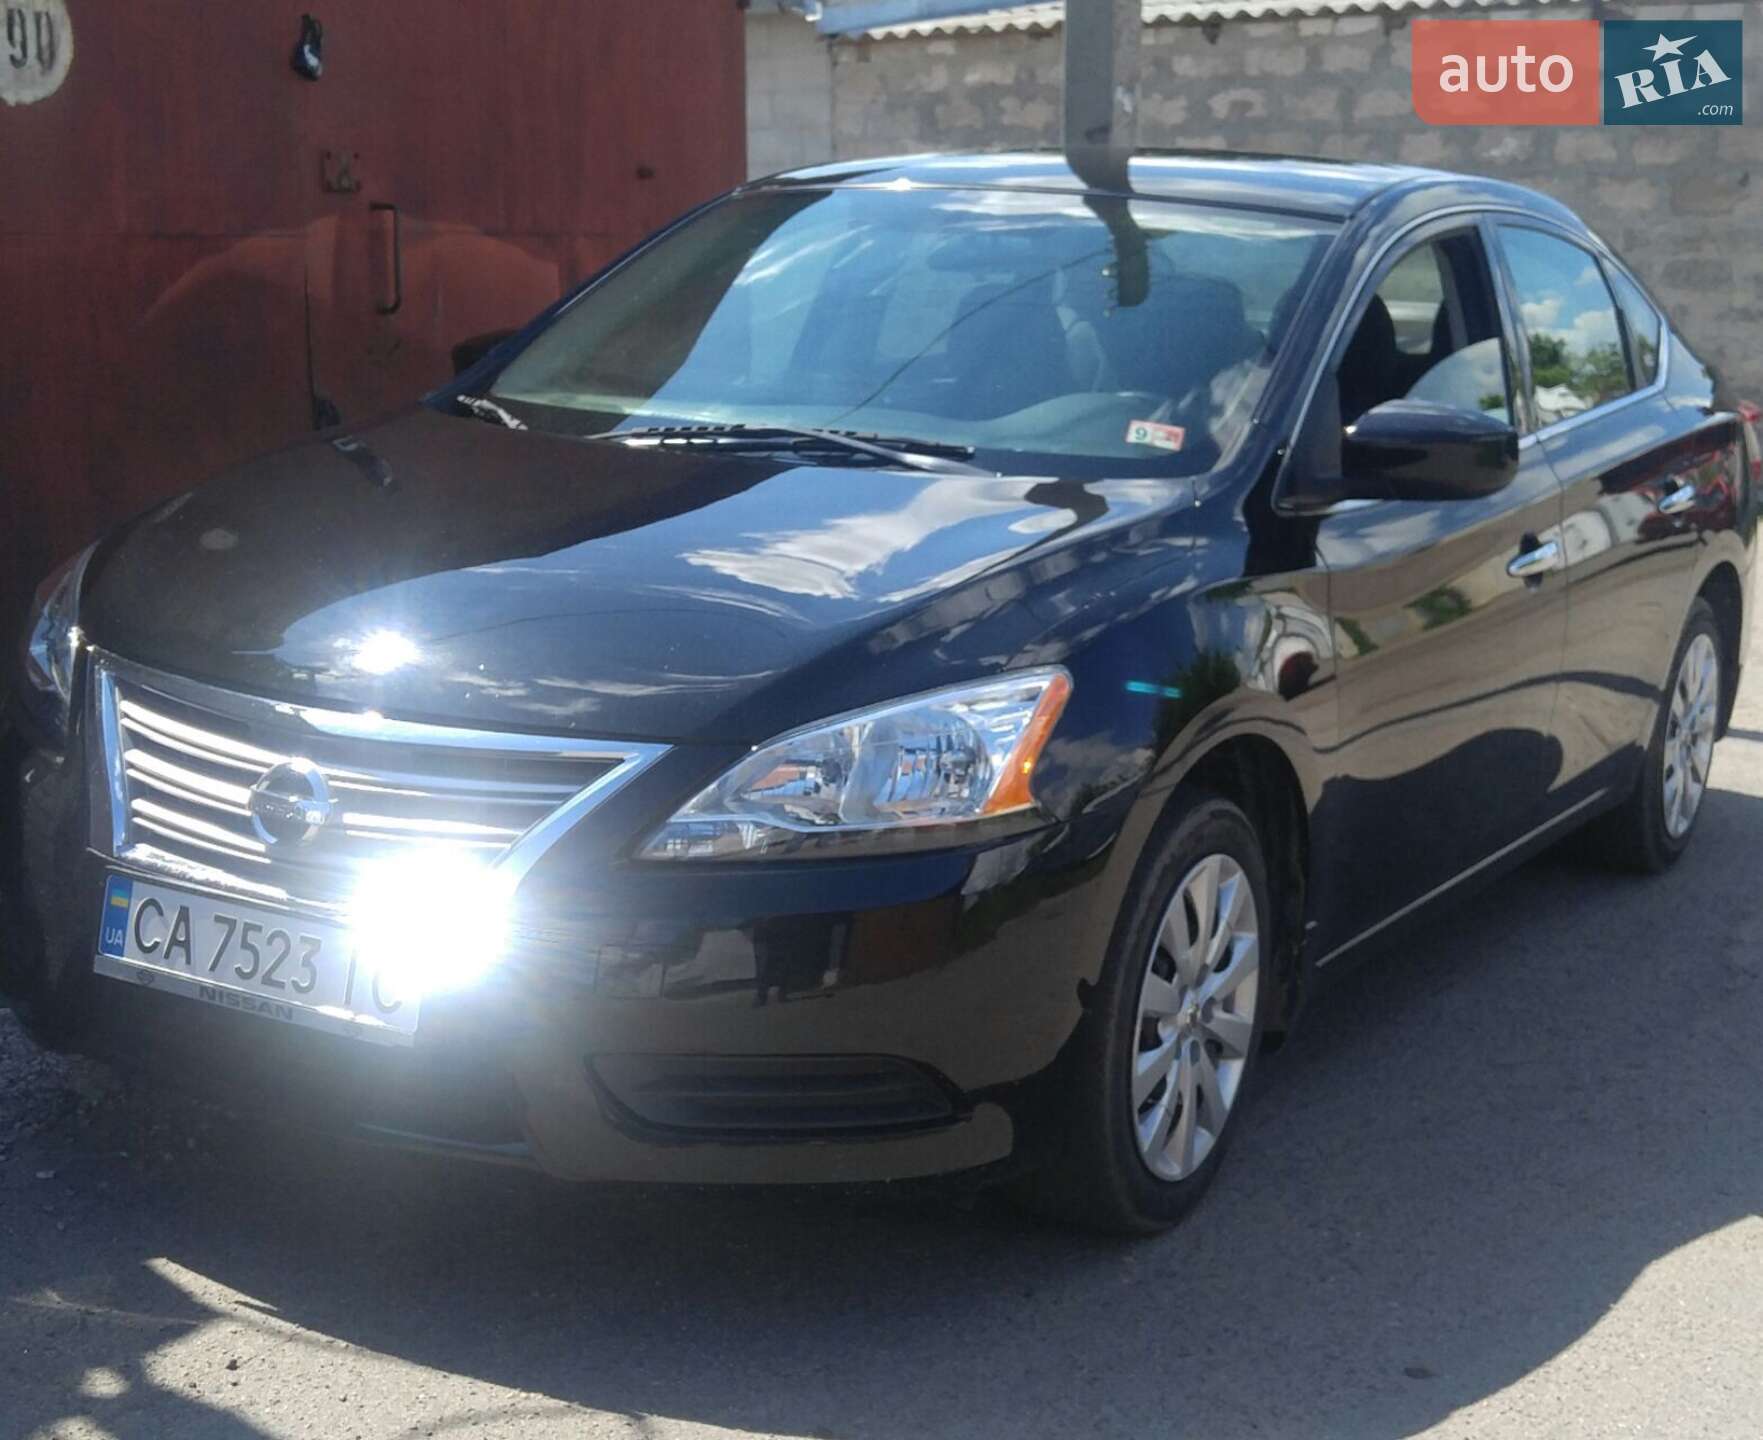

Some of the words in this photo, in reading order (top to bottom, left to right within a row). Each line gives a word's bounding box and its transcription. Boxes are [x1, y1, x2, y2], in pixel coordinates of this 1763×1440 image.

[105, 926, 124, 945] UA
[134, 897, 192, 965] CA
[208, 913, 321, 994] 7523
[201, 985, 294, 1021] NISSAN
